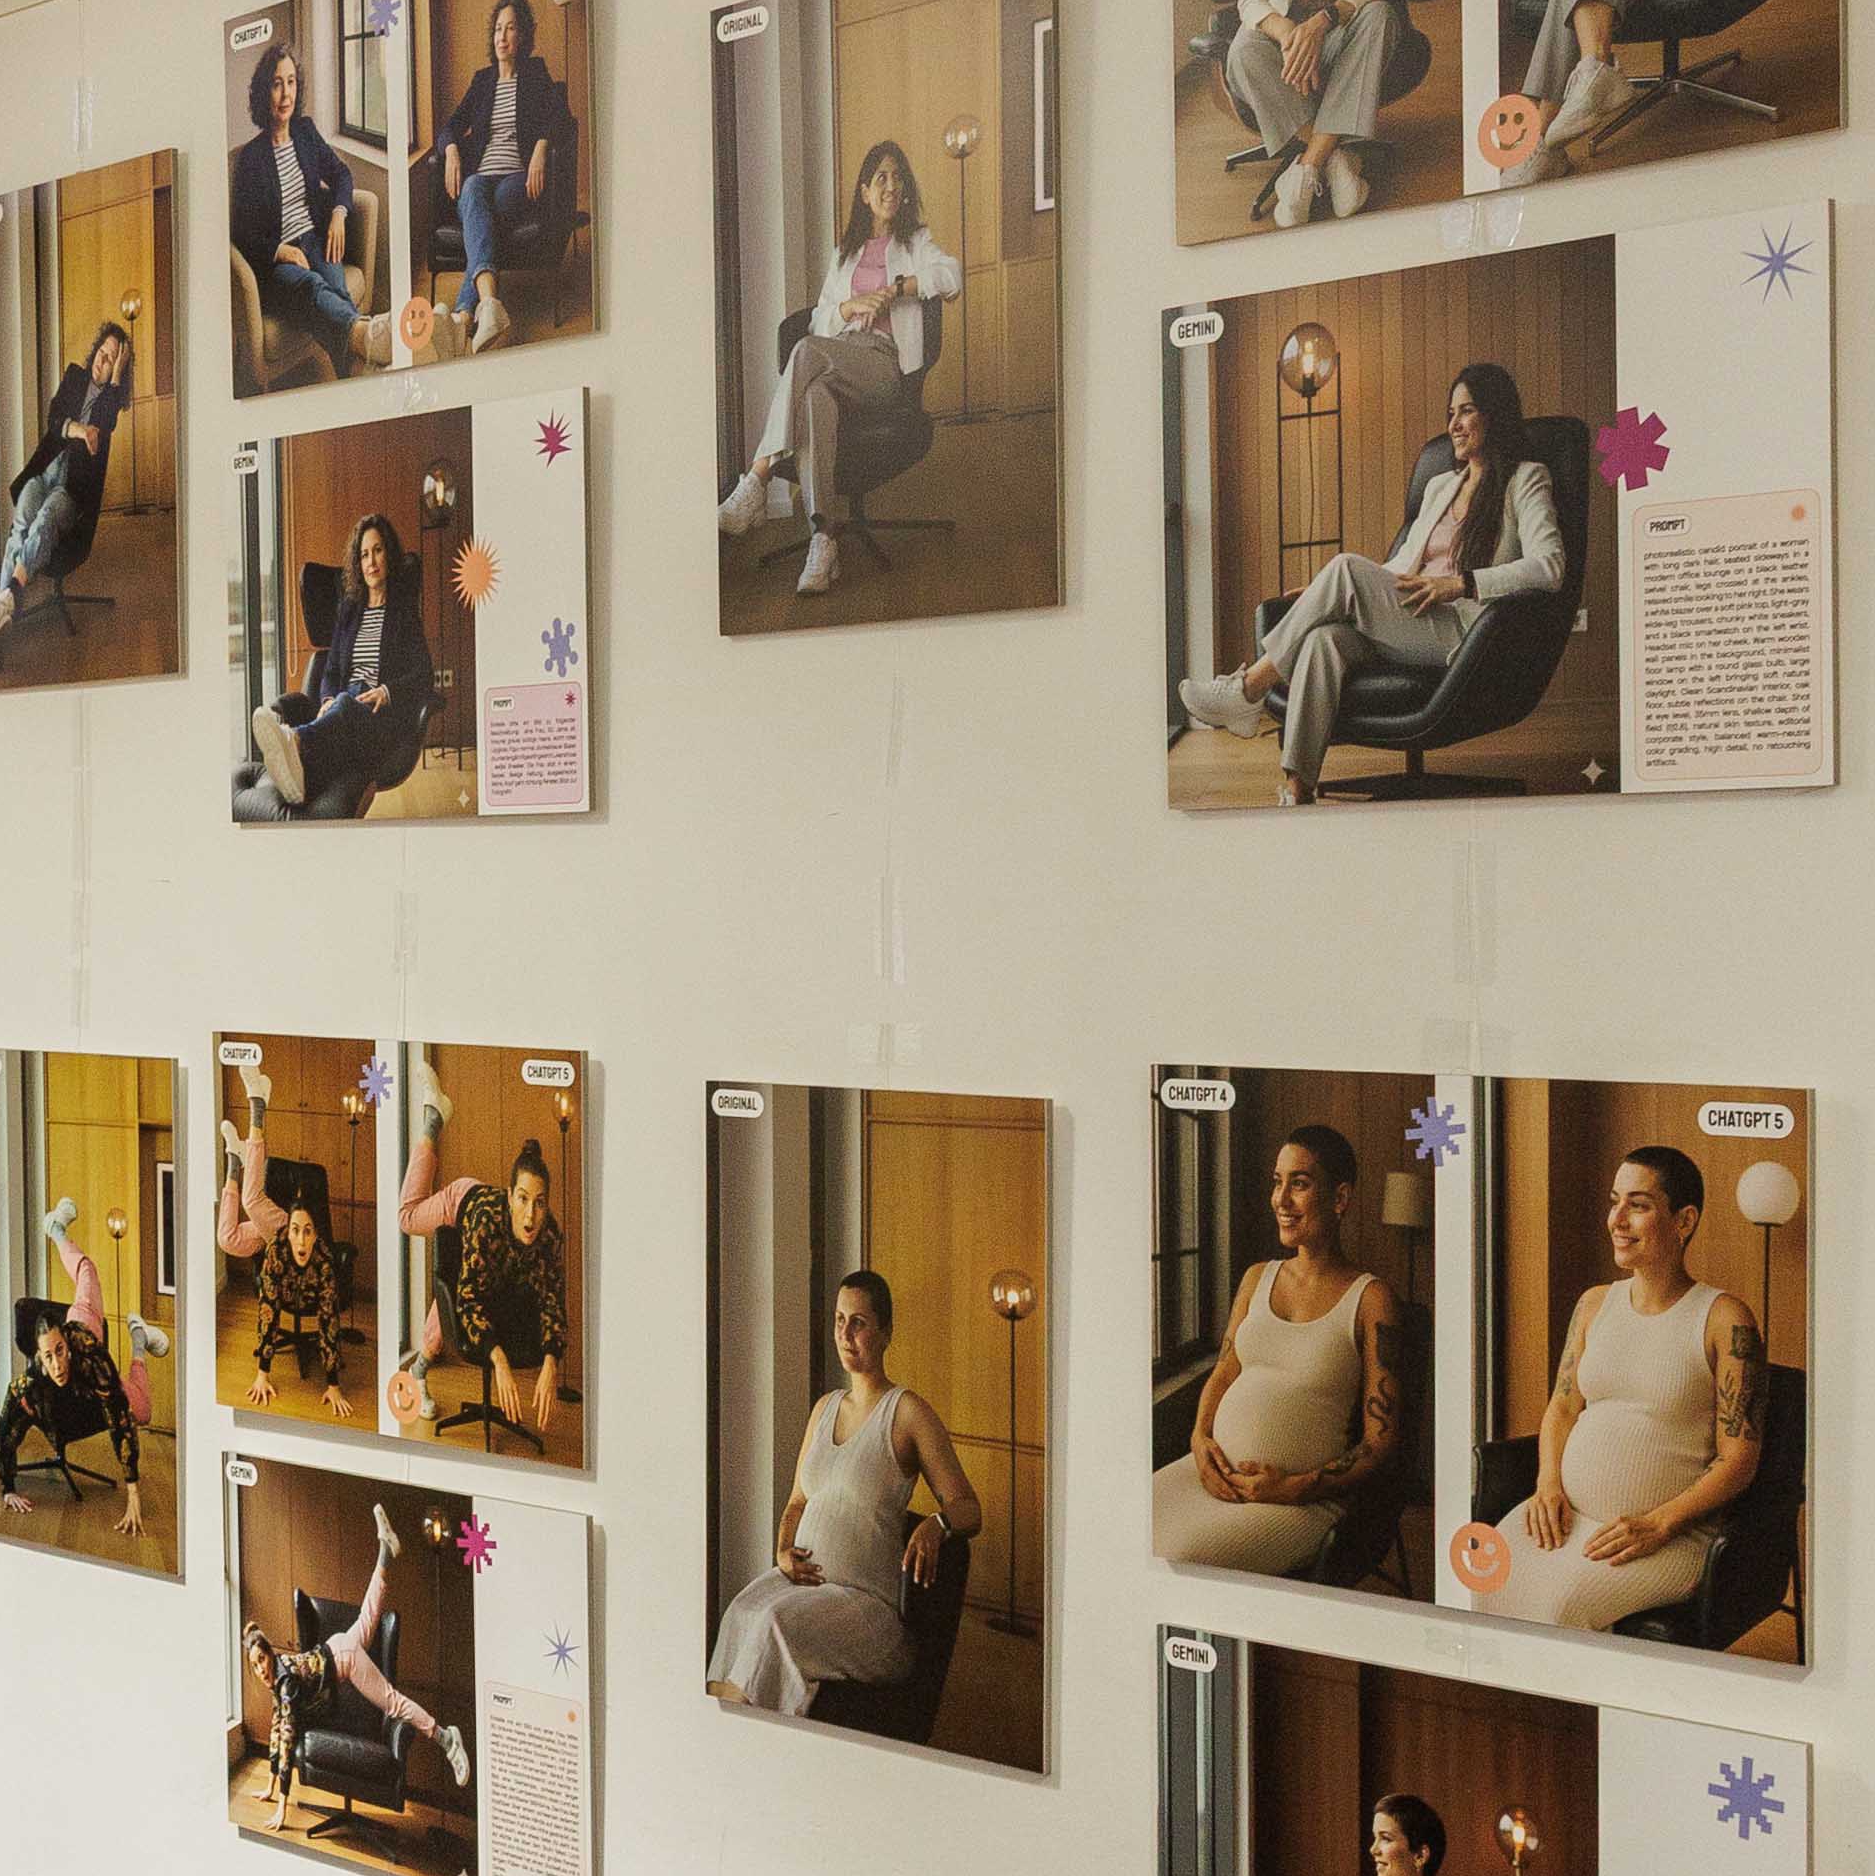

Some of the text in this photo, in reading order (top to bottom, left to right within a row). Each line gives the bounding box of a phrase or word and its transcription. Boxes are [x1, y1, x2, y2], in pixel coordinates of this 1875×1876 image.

[723, 12, 763, 35] ORIGINAL
[234, 25, 268, 45] CHATGPT 4
[1177, 319, 1216, 339] GEMINI
[233, 456, 255, 469] GEMINI
[1650, 519, 1685, 532] PROMPT
[1728, 542, 1757, 553] portrait
[223, 1047, 257, 1063] CHATGPT 4
[527, 1065, 569, 1082] CHATGPT 5
[1168, 1085, 1227, 1103] CHATGPT 4
[717, 1095, 758, 1111] ORIGINAL
[1708, 1110, 1783, 1129] CHATGPT 5
[230, 1465, 252, 1481] GEMINI
[1172, 1643, 1210, 1666] GEMINI
